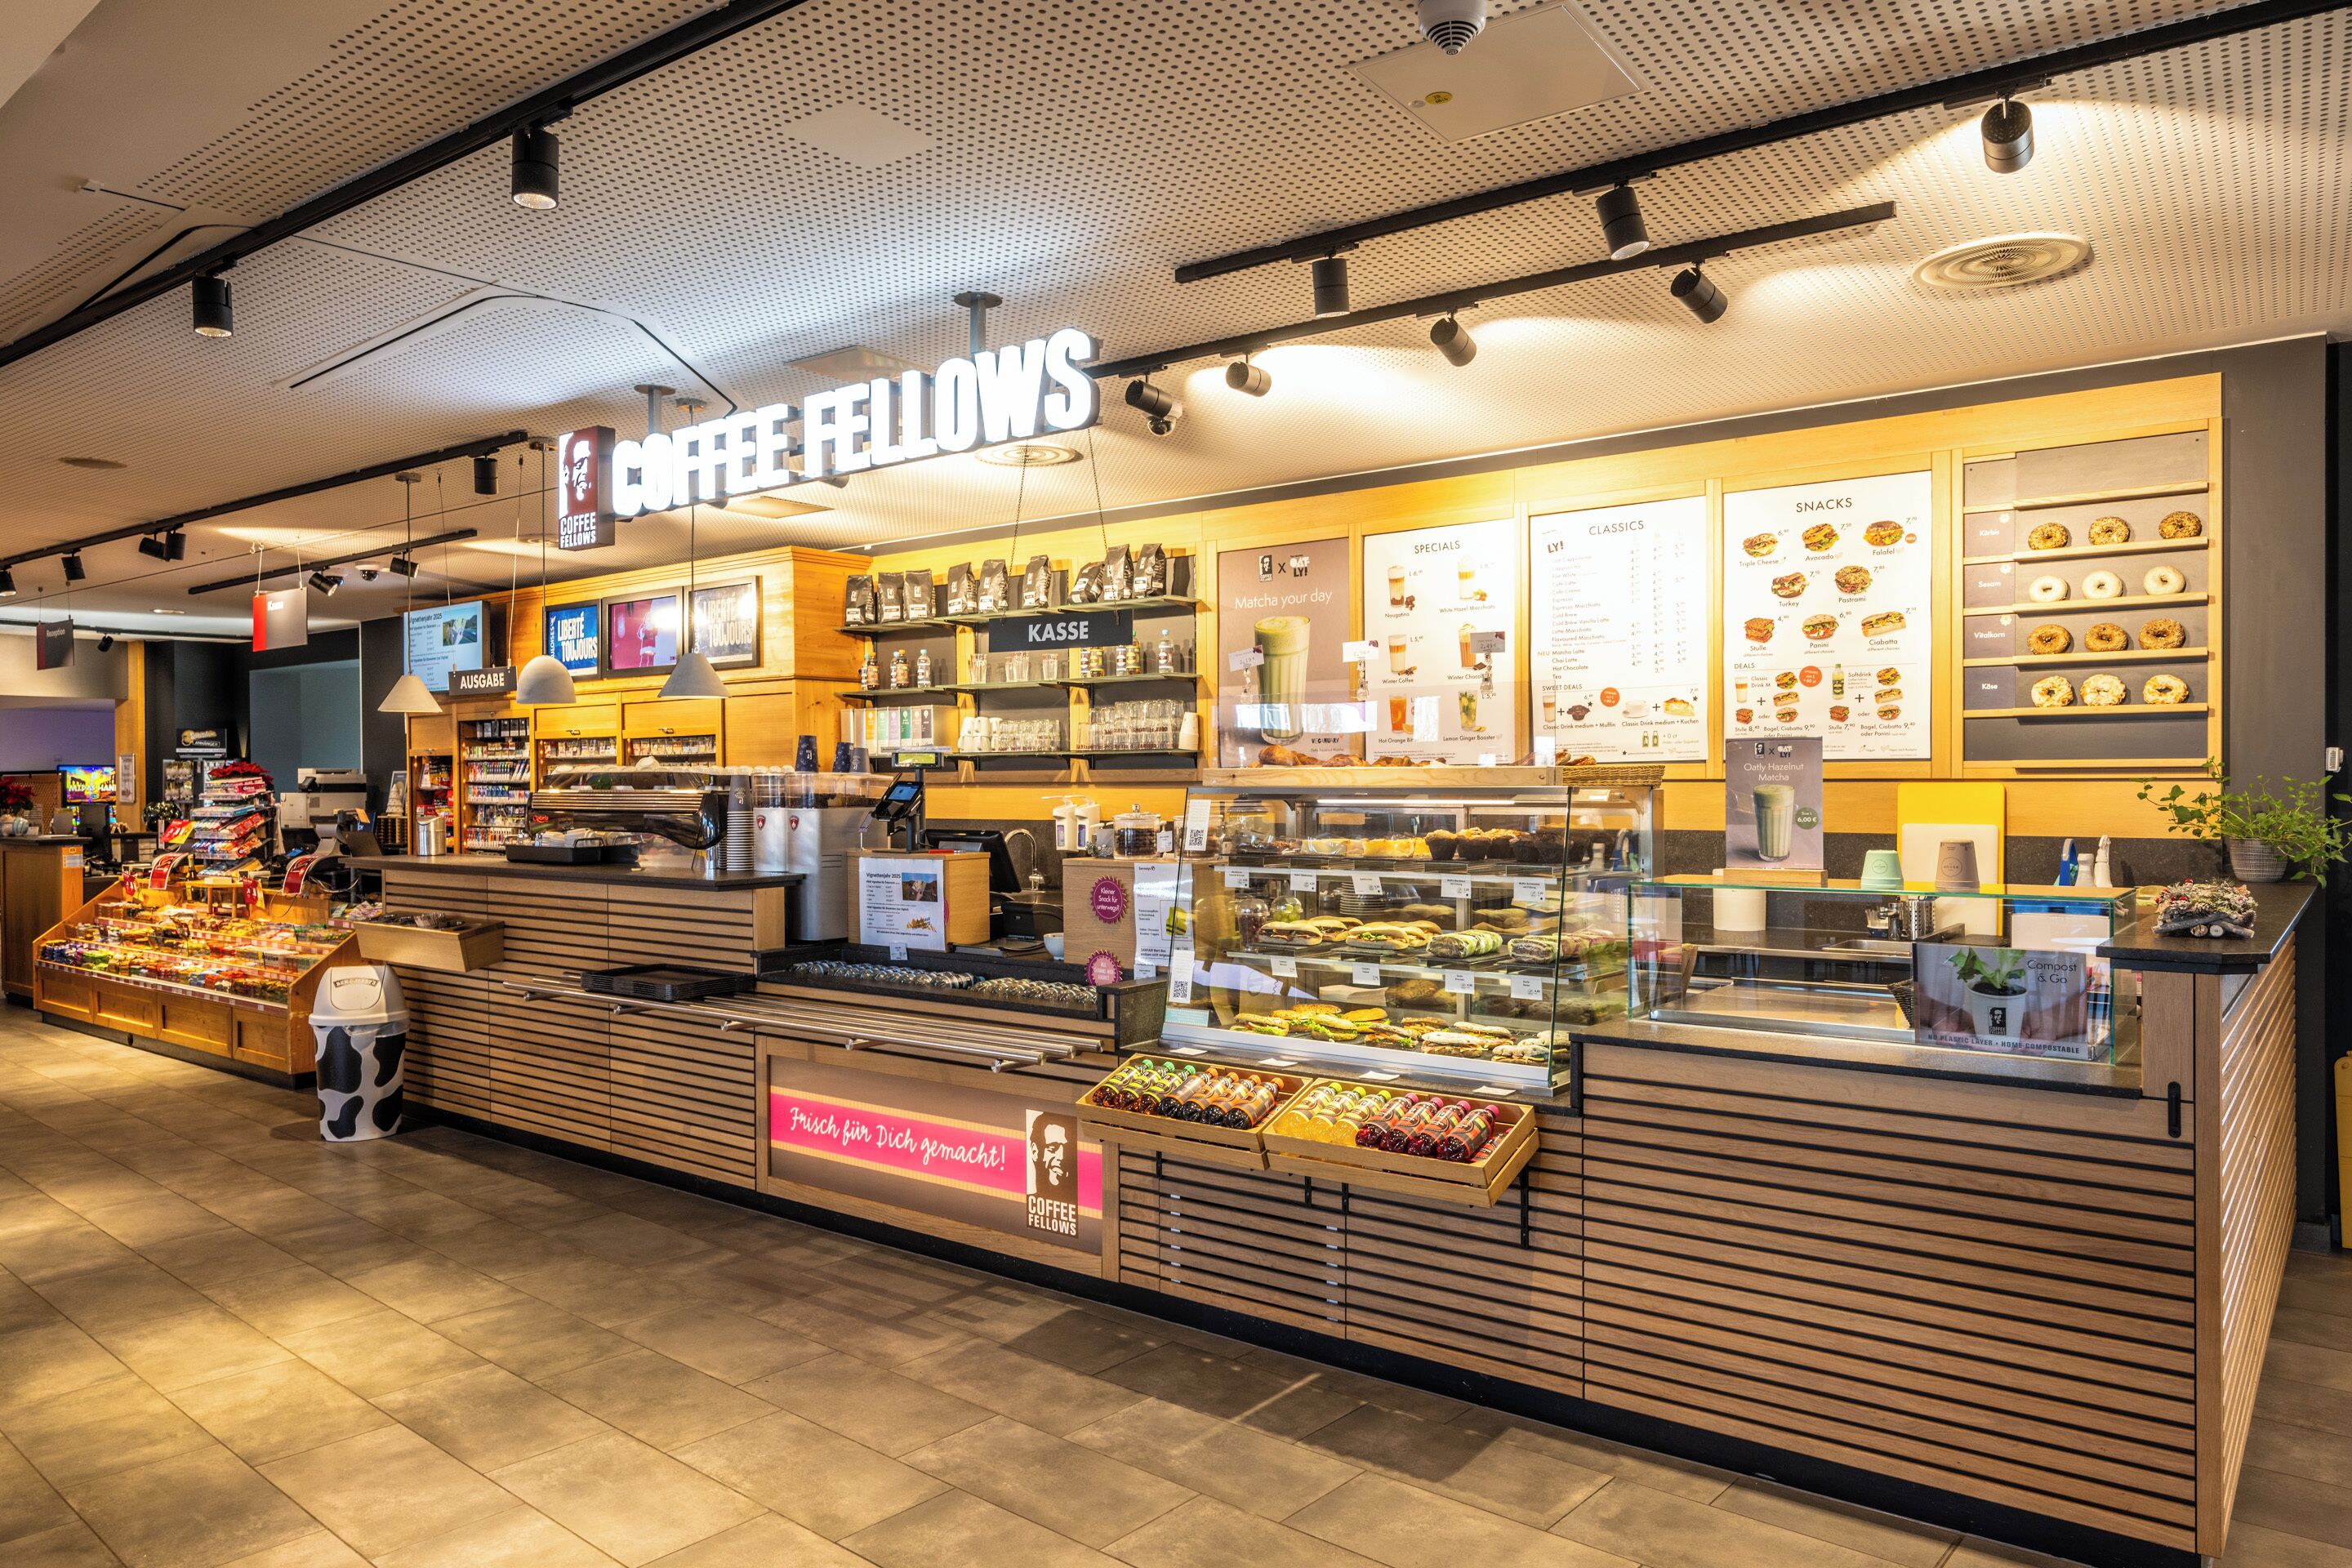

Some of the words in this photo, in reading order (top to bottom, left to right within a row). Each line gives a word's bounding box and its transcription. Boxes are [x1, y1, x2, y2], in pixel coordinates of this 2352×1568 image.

[611, 403, 795, 517] COFFEE
[803, 327, 1098, 479] FELLOWS
[1796, 497, 1853, 513] SNACKS
[560, 512, 596, 535] COFFEE
[1588, 520, 1644, 536] CLASSICS
[559, 529, 596, 548] FELLOWS
[1979, 528, 2000, 537] Kürbis
[1414, 540, 1460, 555] SPECIALS
[1235, 595, 1278, 610] Matcha
[1281, 591, 1307, 609] your
[1310, 588, 1333, 606] day
[408, 614, 434, 625] ignettenjahr
[557, 611, 585, 642] LIBERTÉ
[46, 628, 65, 638] Reception
[1028, 621, 1089, 643] KASSE
[1973, 630, 2006, 639] Vitalkorn
[561, 636, 598, 662] TOUJOURS
[1869, 638, 1898, 646] Ciabatta
[459, 672, 506, 690] AUSGABE
[1981, 682, 1998, 690] Käse
[1744, 763, 1766, 773] Oatly
[1768, 762, 1804, 771] Hazelnut
[1758, 773, 1789, 782] Matcha
[68, 784, 96, 792] MIDAS
[1100, 887, 1116, 895] Kleiner
[1096, 904, 1120, 913] unterwegs?
[2027, 960, 2078, 973] Compost
[2037, 973, 2047, 983] &
[2049, 973, 2068, 984] Go
[1940, 1035, 1969, 1044] PLASTIC
[1971, 1038, 1993, 1046] LAYER
[2001, 1041, 2023, 1049] HOME
[2025, 1043, 2080, 1054] COMPOSTABLE
[790, 1106, 840, 1139] Frisch
[843, 1119, 872, 1147] für
[876, 1124, 918, 1153] Dich
[920, 1136, 1007, 1172] gemacht!
[1027, 1195, 1077, 1223] COFFEE
[1027, 1214, 1077, 1236] FELLOWS
